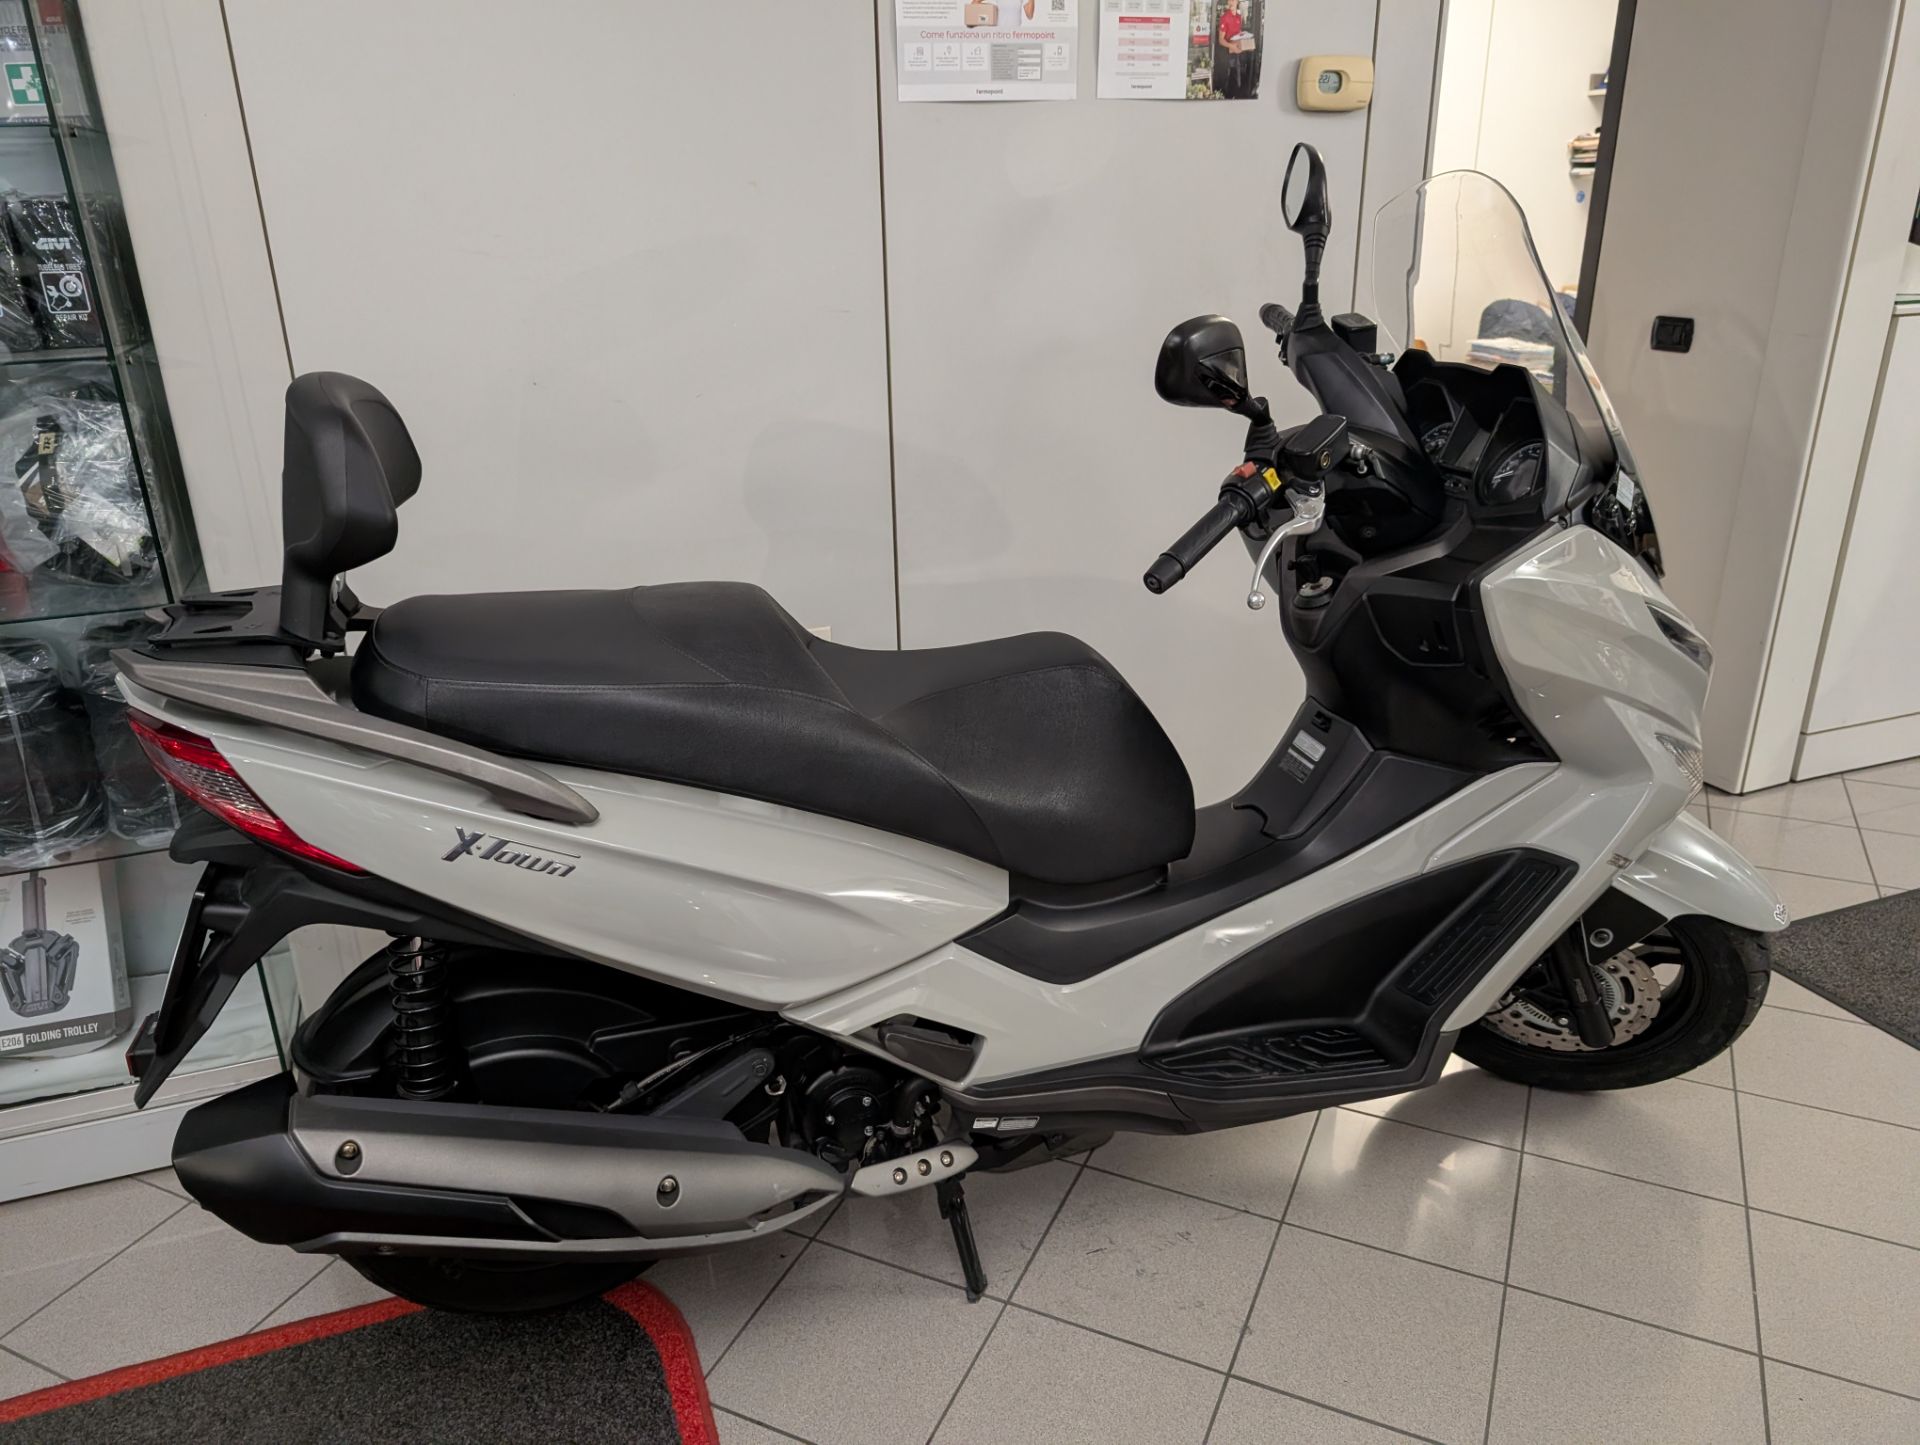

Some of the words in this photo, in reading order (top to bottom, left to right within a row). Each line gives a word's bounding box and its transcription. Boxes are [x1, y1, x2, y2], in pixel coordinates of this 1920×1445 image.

[920, 30, 945, 39] Come
[946, 30, 980, 39] funziona
[993, 30, 1012, 39] ritiro
[1012, 30, 1056, 40] fermopoint
[35, 237, 72, 250] GIVI
[66, 263, 82, 271] TIRES
[78, 313, 89, 321] KIT
[1, 1034, 22, 1048] E206
[25, 1029, 62, 1044] FOLDING
[63, 1022, 99, 1038] TROLLEY
